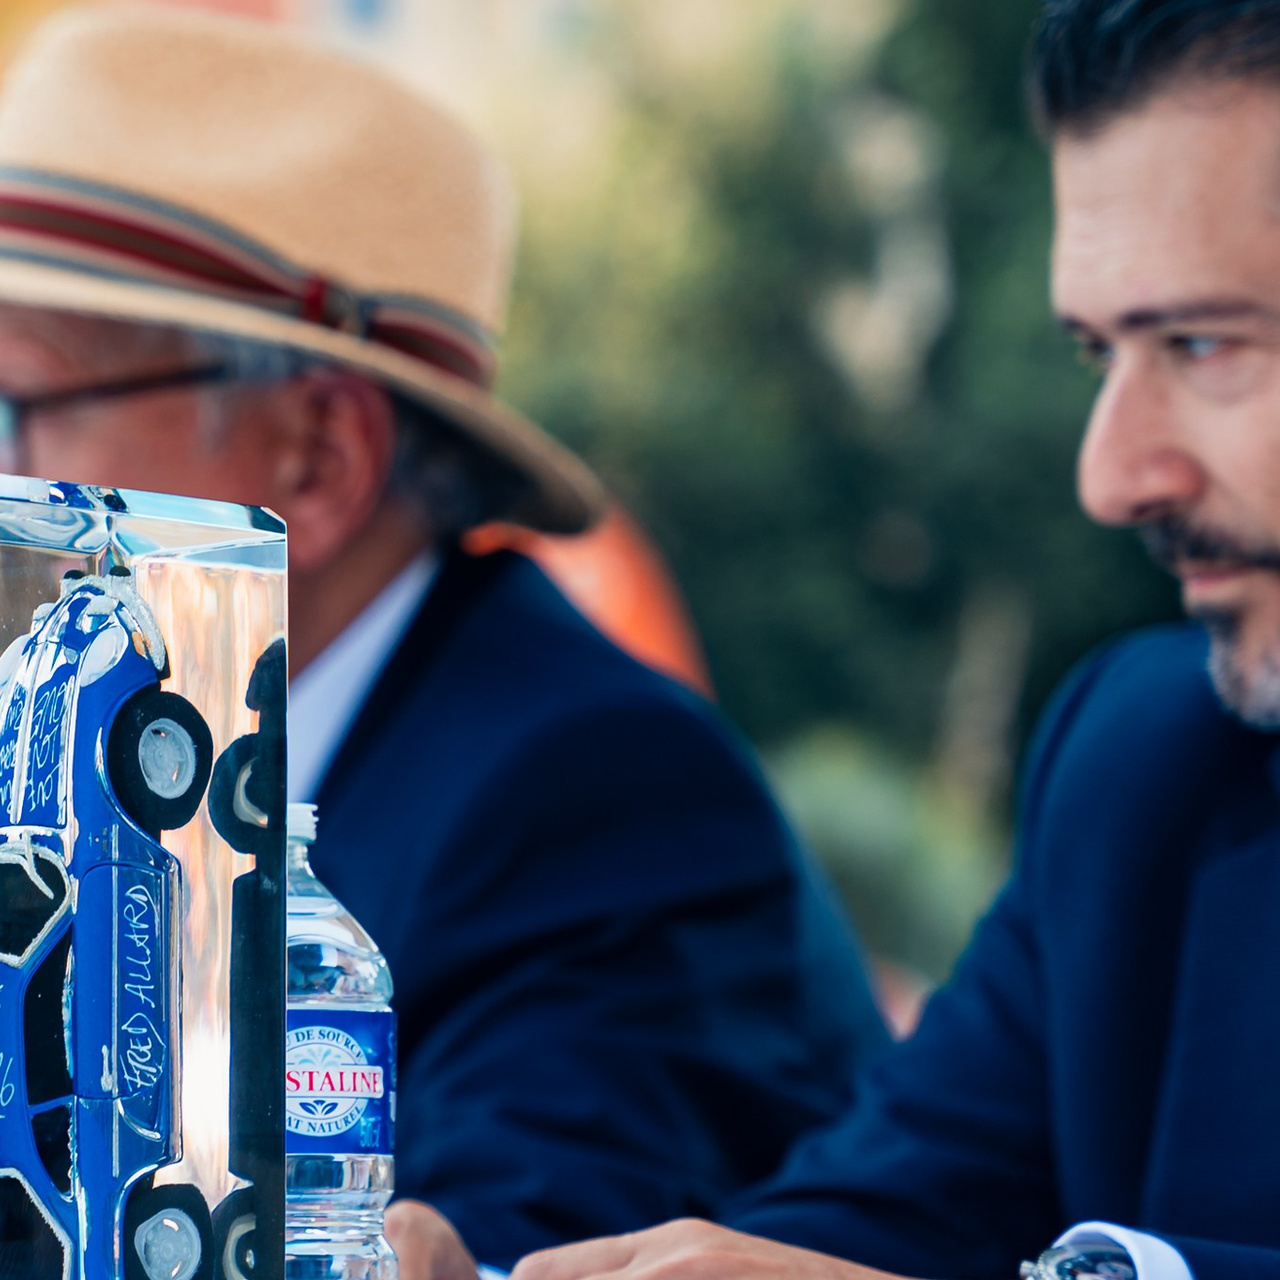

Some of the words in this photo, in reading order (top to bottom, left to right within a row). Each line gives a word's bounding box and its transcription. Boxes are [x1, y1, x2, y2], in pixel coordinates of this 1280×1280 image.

[123, 884, 160, 1009] ALLARD
[120, 1011, 166, 1092] FRED
[295, 1029, 315, 1043] DE
[306, 1106, 364, 1134] NATUREL
